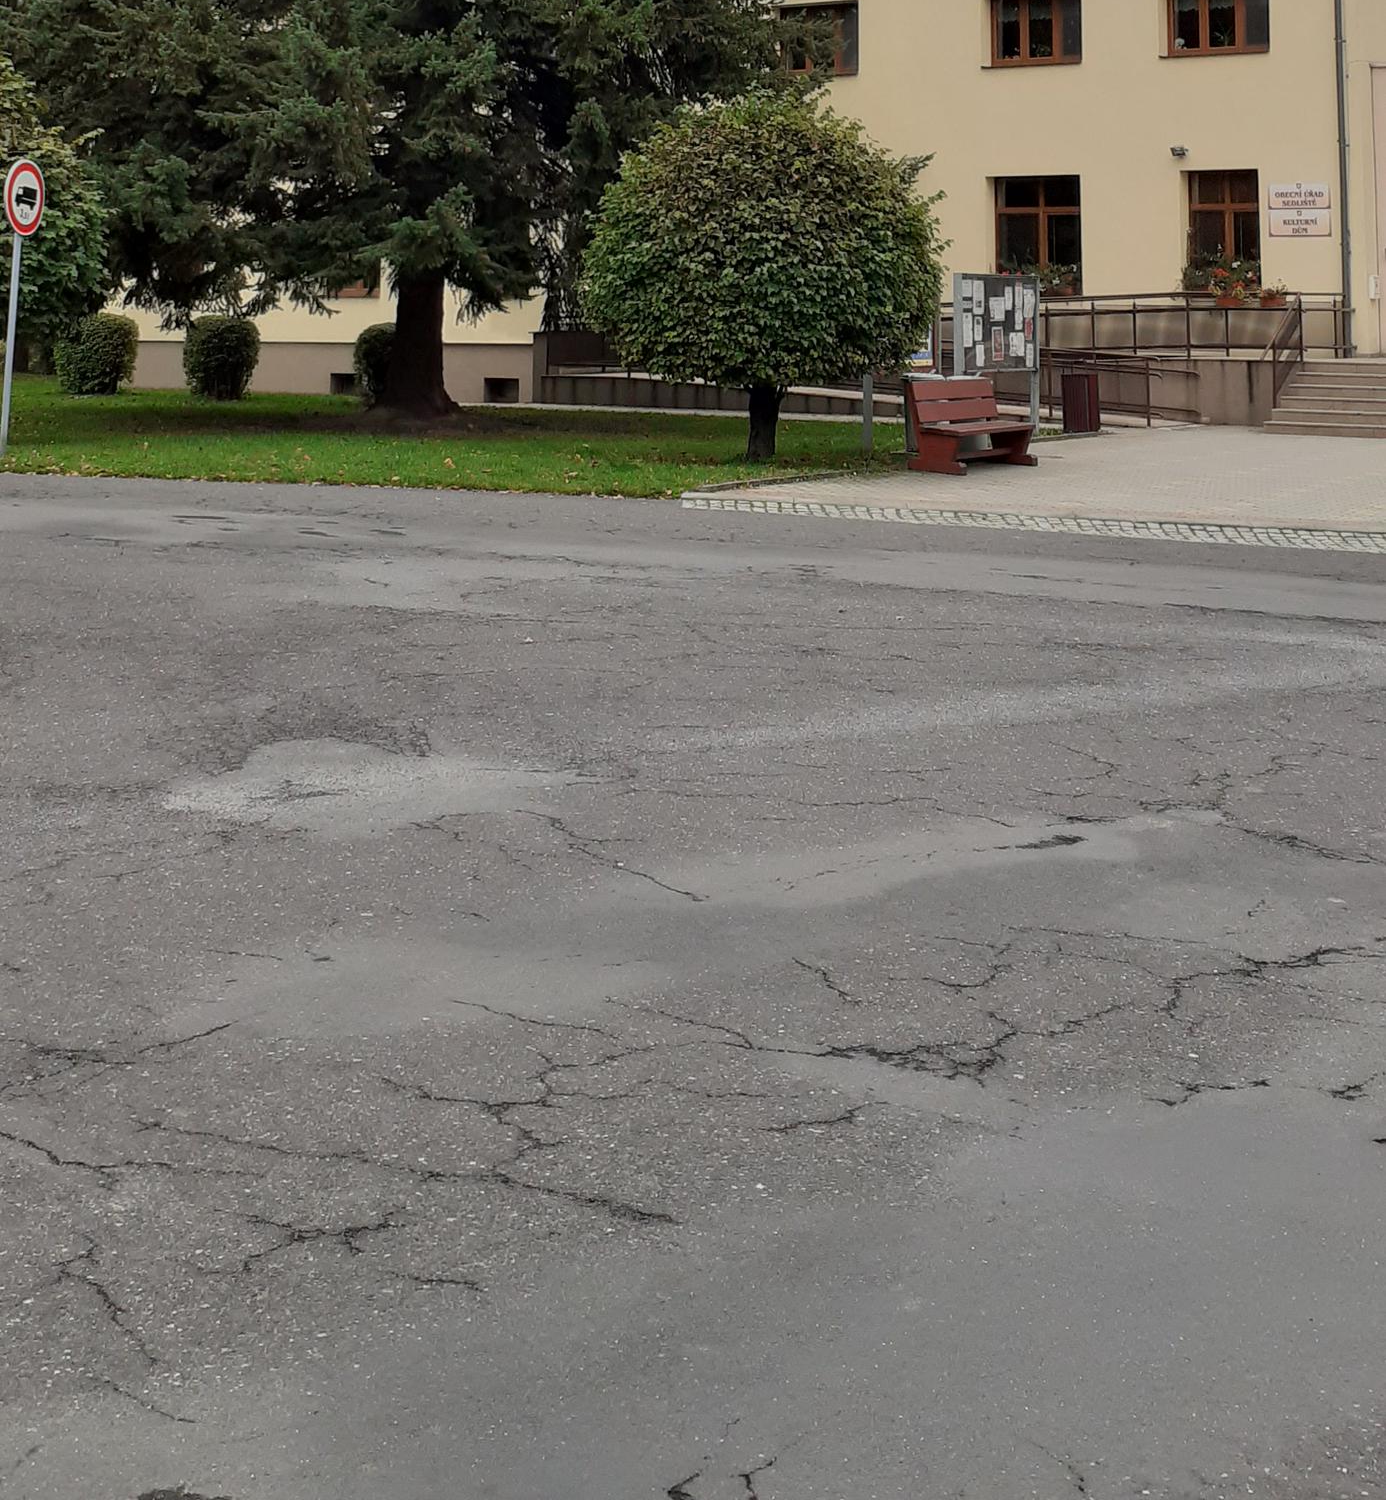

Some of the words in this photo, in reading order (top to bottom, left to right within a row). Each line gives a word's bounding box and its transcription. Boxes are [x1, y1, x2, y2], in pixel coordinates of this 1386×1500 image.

[1274, 190, 1302, 198] OBECNÍ
[1304, 189, 1324, 198] ÚŘAD
[1283, 217, 1318, 226] KULTURNÍ
[1292, 226, 1308, 234] DŮM
